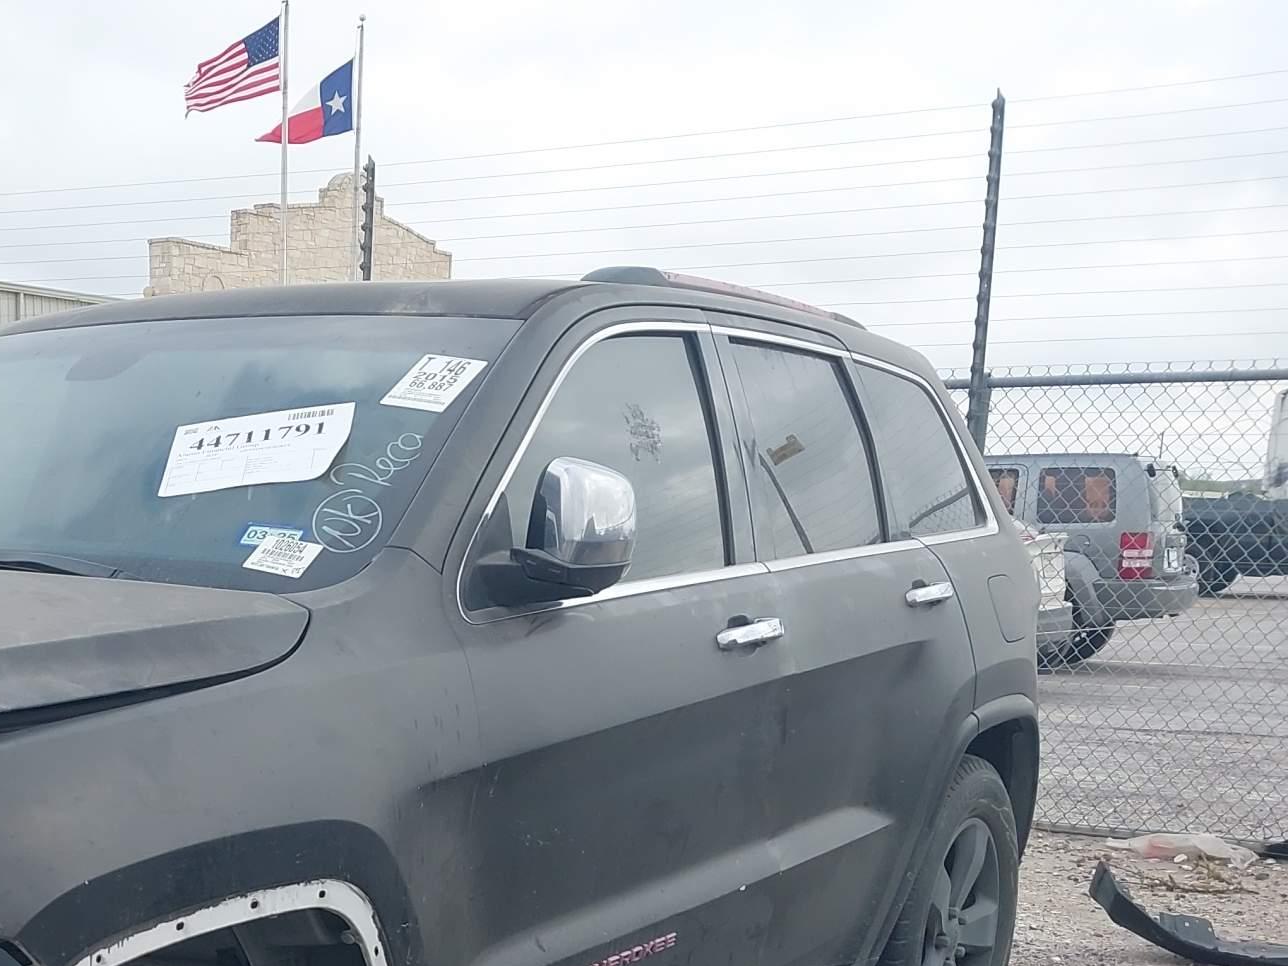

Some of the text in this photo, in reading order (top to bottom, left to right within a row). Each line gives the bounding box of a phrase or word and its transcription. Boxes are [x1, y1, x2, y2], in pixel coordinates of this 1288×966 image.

[419, 357, 471, 376] T 146
[413, 371, 460, 384] 2015
[189, 421, 325, 451] 44711791
[247, 530, 268, 540] 03
